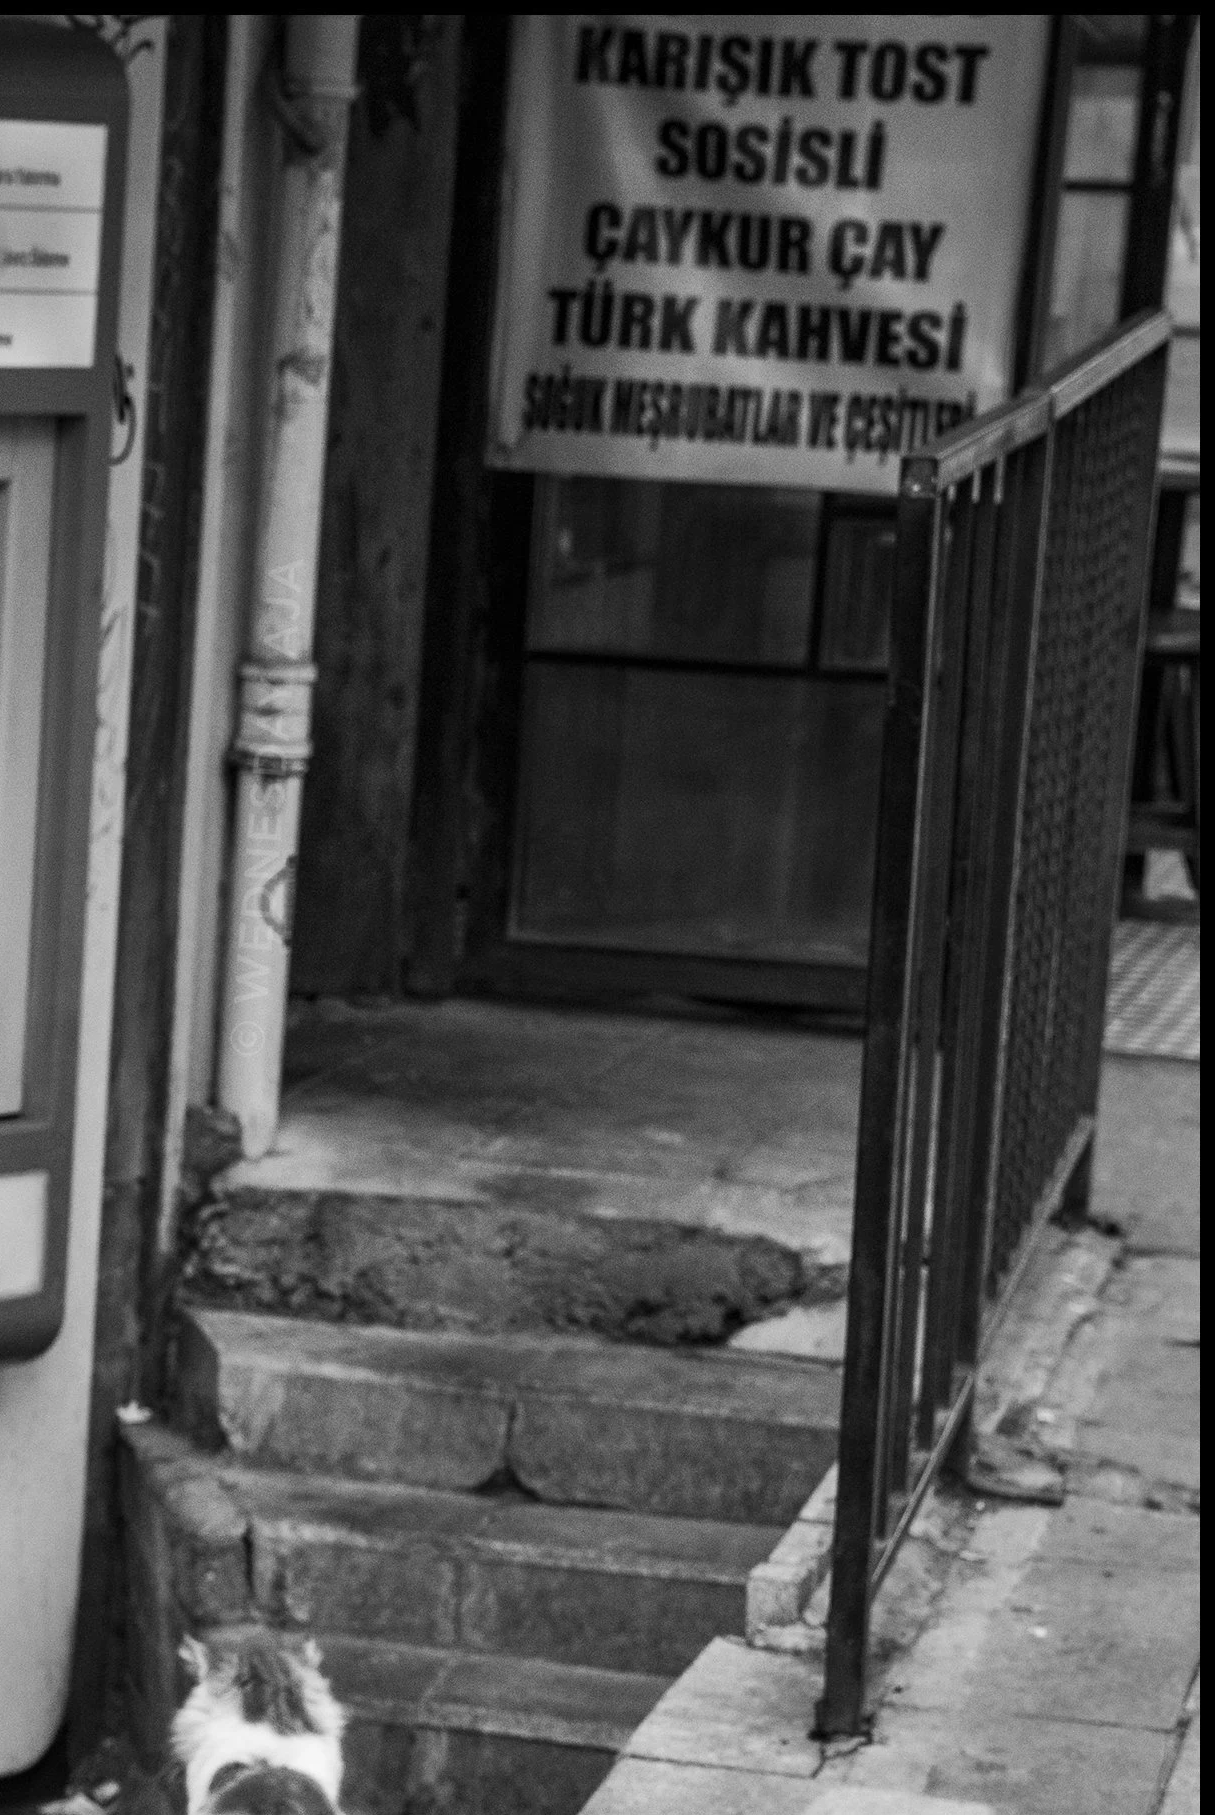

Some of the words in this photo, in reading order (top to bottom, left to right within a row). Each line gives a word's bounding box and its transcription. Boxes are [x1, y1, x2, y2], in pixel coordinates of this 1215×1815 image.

[575, 26, 816, 106] KARIŞIK
[833, 40, 991, 105] TOST
[654, 115, 885, 191] SOSİSLİ
[586, 202, 813, 274] ÇAYKUR
[828, 218, 946, 291] ÇAY
[547, 279, 696, 354] TÜRK
[711, 302, 968, 373] KAHVESİ
